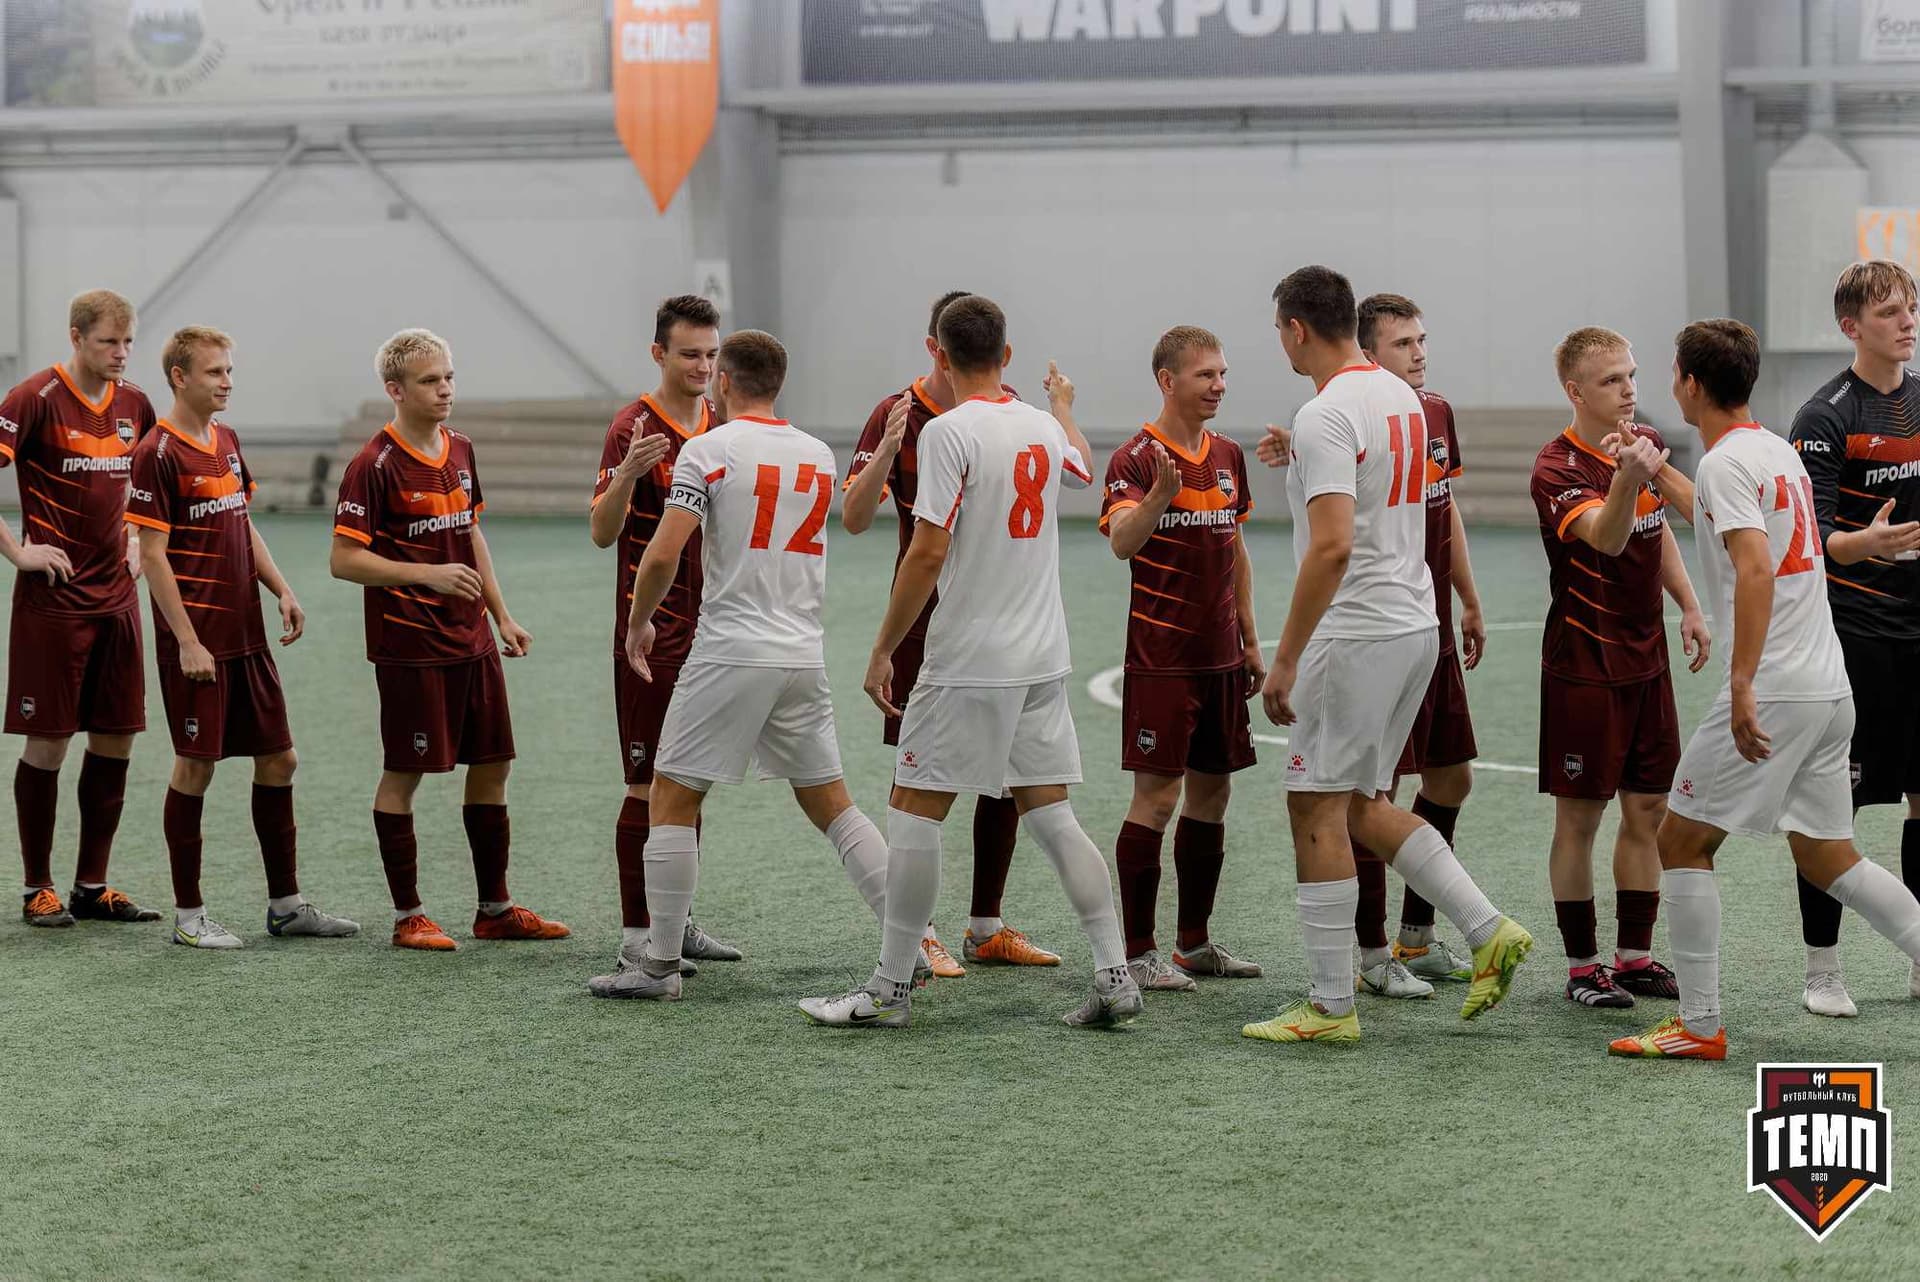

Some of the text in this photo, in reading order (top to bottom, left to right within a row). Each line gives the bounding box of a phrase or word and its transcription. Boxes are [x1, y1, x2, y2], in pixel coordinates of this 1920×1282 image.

[984, 0, 1418, 42] WARPOINT
[1008, 444, 1050, 539] 8
[1386, 413, 1425, 508] 11
[1803, 440, 1831, 453] ПСБ
[749, 463, 832, 556] 12
